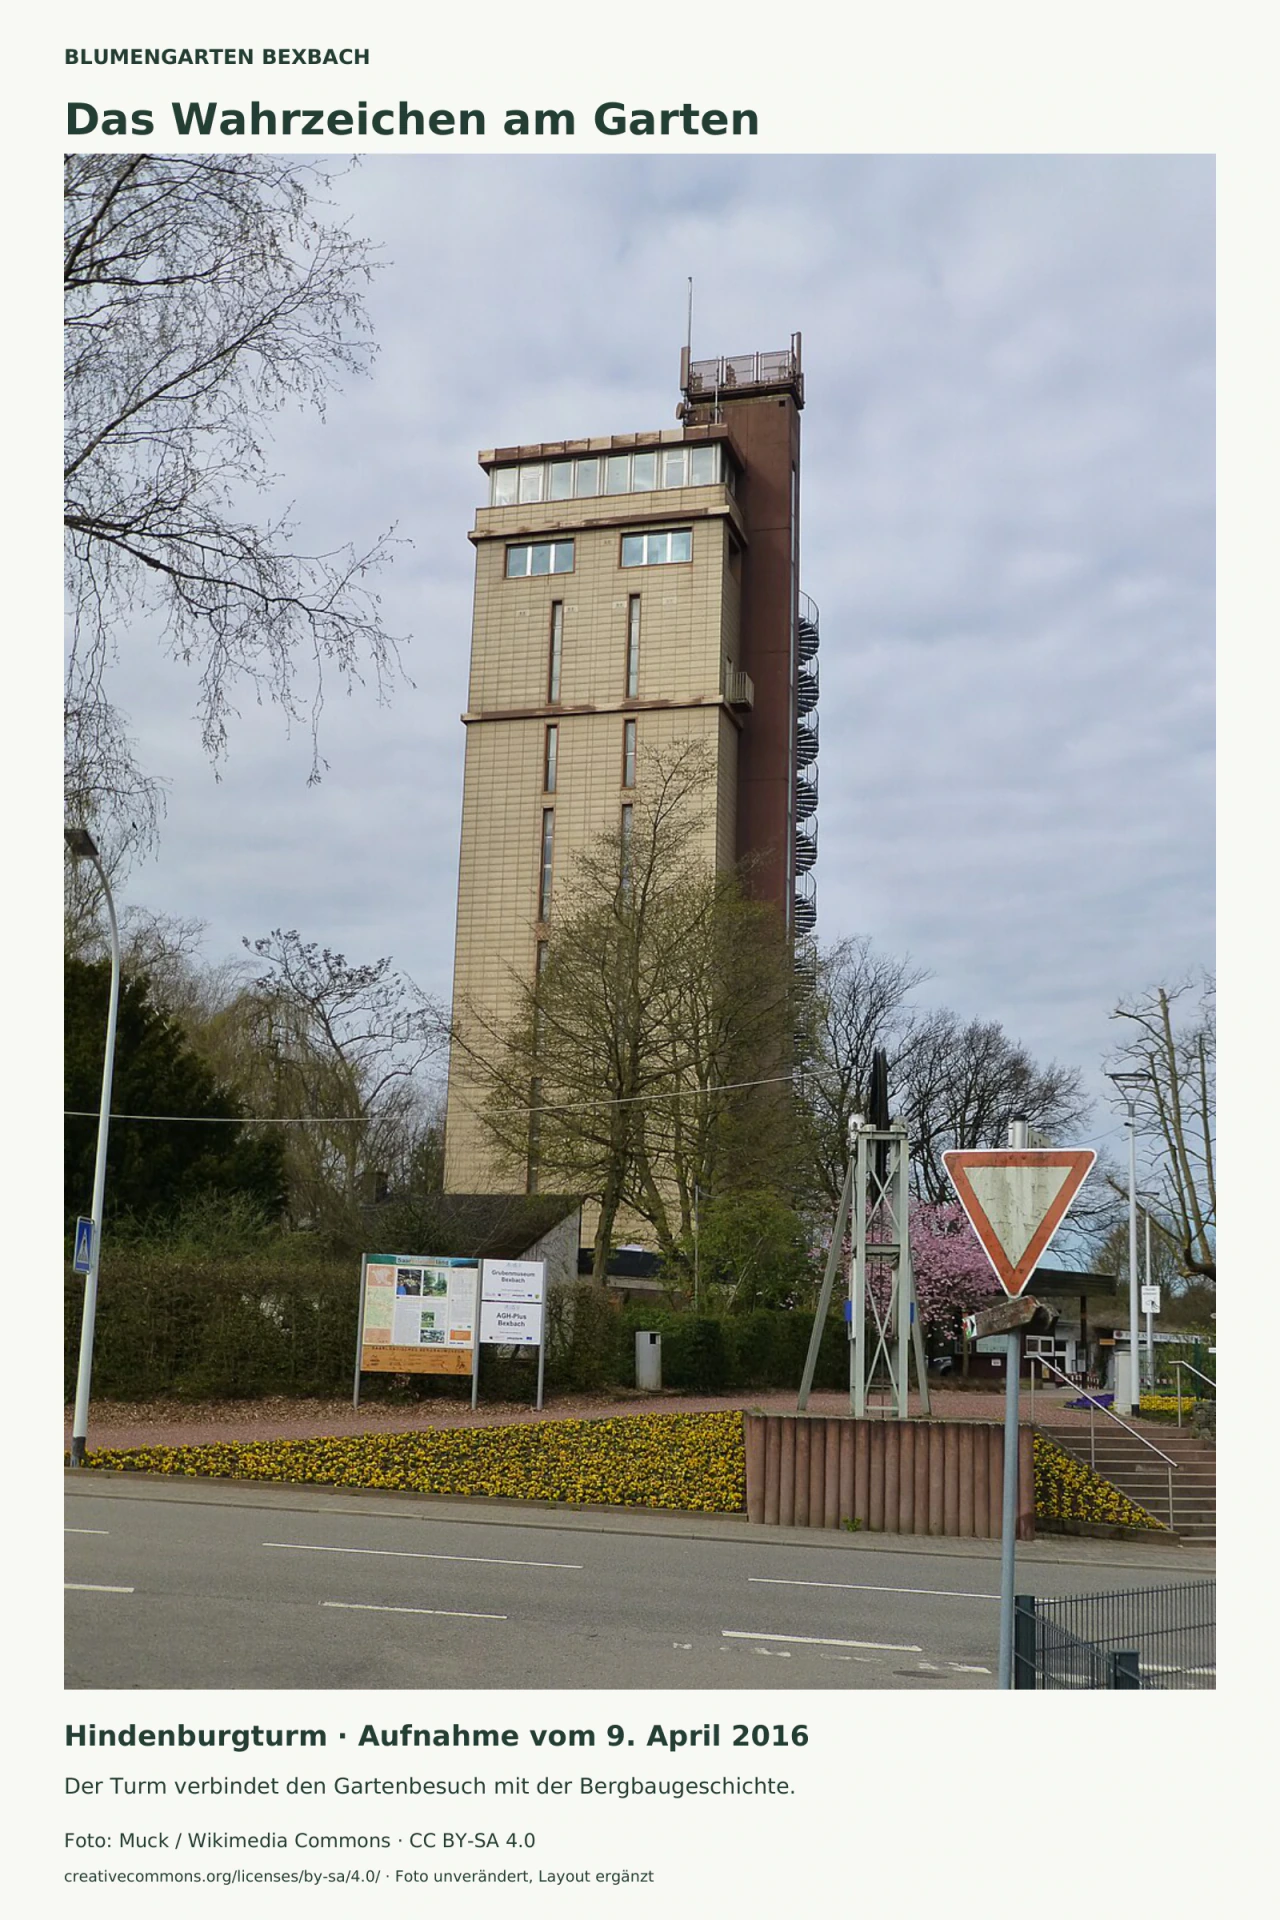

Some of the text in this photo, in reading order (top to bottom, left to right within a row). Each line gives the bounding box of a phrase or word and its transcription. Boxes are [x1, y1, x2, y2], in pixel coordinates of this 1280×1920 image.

[491, 1269, 535, 1277] Grubenmuseum
[501, 1276, 525, 1284] Bexbach
[496, 1312, 527, 1320] AGH-Plus
[498, 1319, 525, 1328] Bexbach
